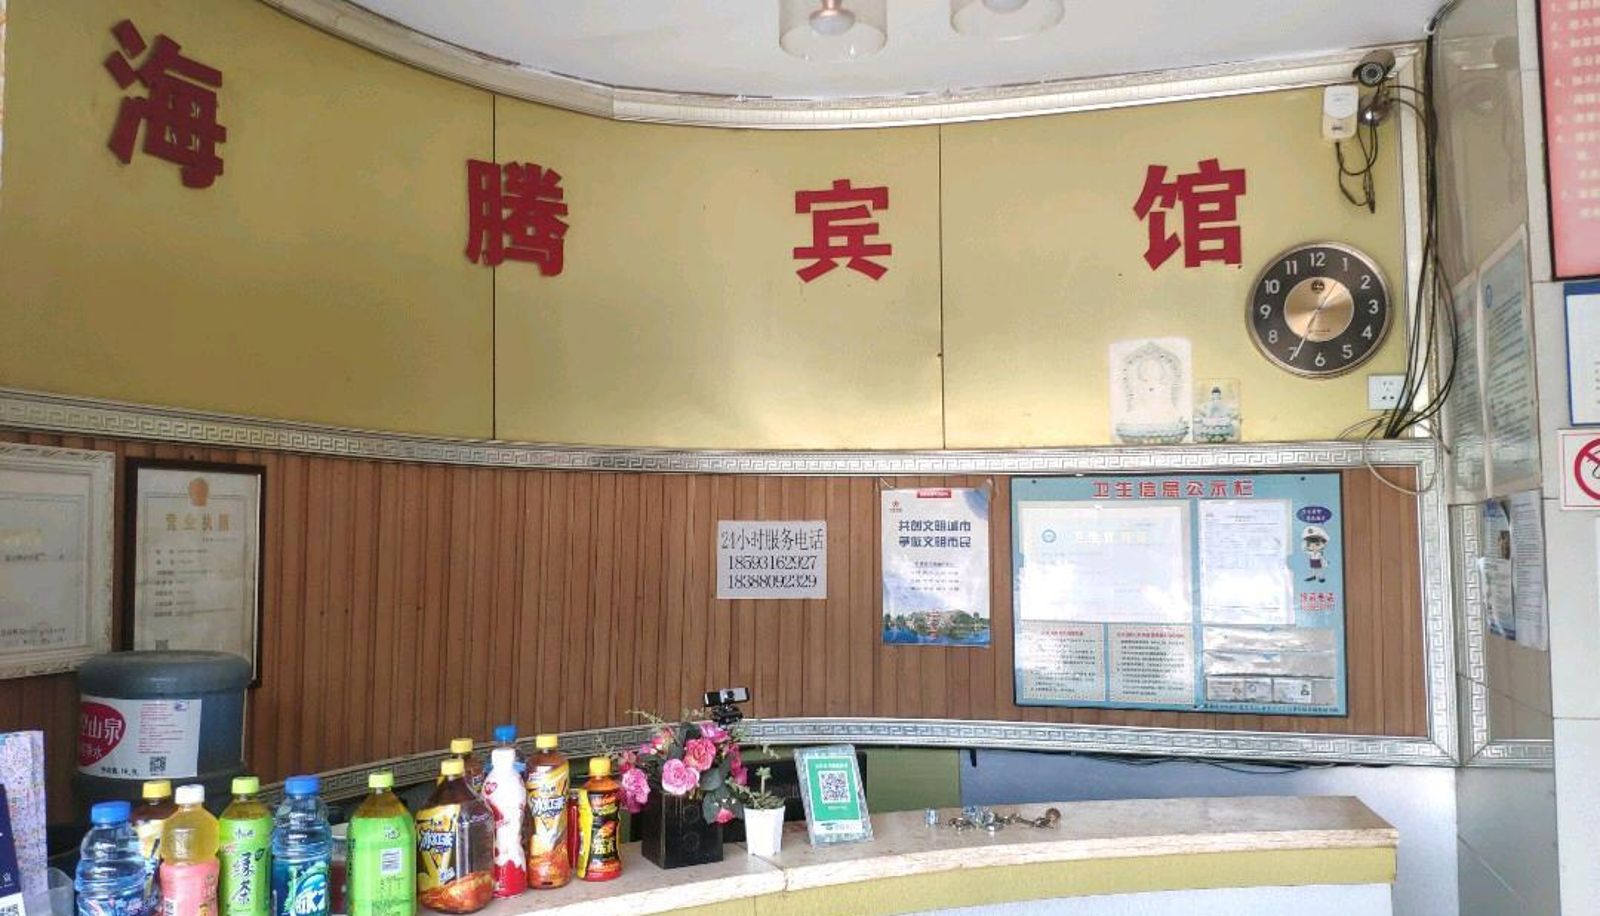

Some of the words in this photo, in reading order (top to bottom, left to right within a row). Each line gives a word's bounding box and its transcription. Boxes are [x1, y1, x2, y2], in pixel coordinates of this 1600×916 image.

[1310, 252, 1325, 266] 12
[1343, 258, 1348, 271] 1
[1285, 260, 1297, 274] 11
[1265, 279, 1279, 294] 10
[1361, 275, 1371, 289] 2
[1260, 304, 1271, 319] 9
[1369, 299, 1379, 314] 3
[1268, 329, 1278, 344] 8
[1362, 325, 1372, 340] 4
[1342, 345, 1353, 359] 5
[1315, 353, 1326, 367] 6
[1091, 479, 1253, 498] 卫生信息公示栏
[898, 519, 971, 531] 共创文明城市
[721, 528, 824, 551] 24小时服务电话
[729, 555, 817, 570] 18593162927
[729, 574, 818, 589] 18388092329
